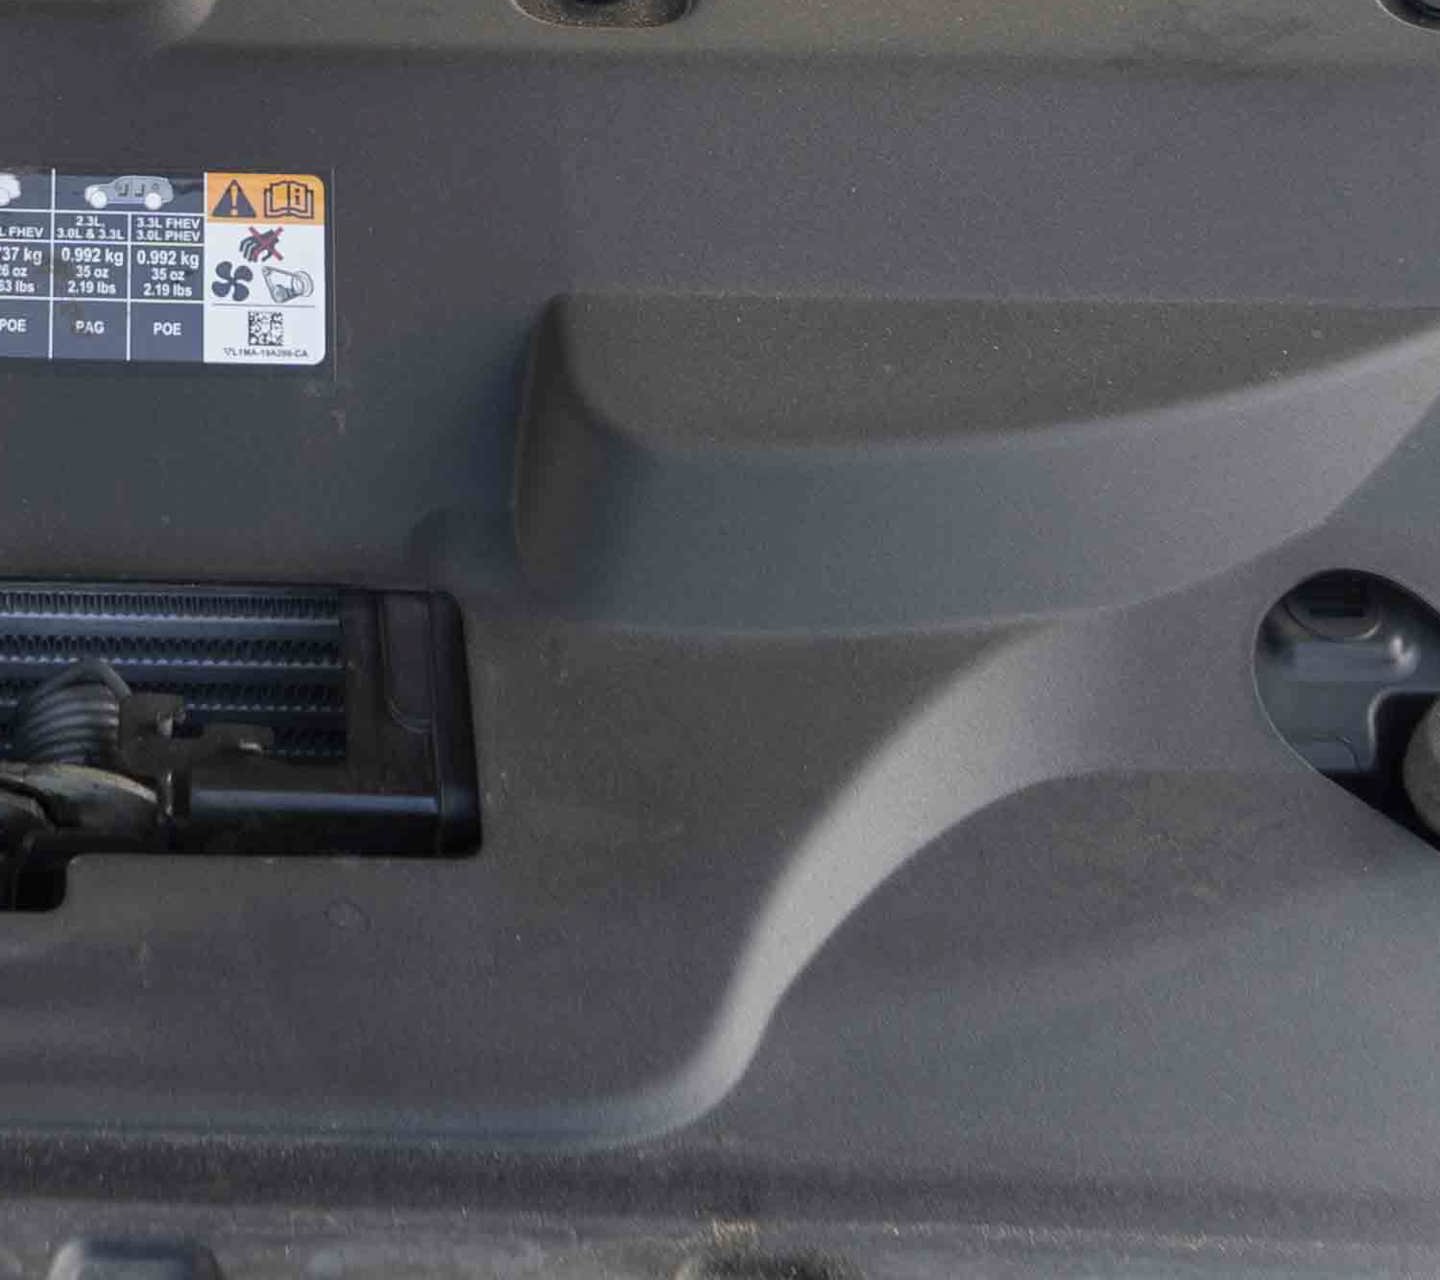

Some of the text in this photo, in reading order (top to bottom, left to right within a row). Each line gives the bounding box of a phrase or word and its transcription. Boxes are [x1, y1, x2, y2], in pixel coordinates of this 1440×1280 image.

[136, 217, 201, 229] 3.3L FHEV
[8, 226, 44, 238] FHEV
[56, 227, 125, 240] 3.0L & 3.3L
[136, 229, 201, 242] 3.0L PHEV
[23, 247, 43, 266] kg
[61, 247, 124, 266] 0.992 kg
[136, 249, 200, 269] 0.992 kg
[12, 266, 28, 277] oz
[75, 265, 110, 279] 35 oz
[151, 267, 185, 281] 35 oz
[15, 280, 35, 293] lbs
[67, 280, 117, 295] 2.19 lbs
[143, 282, 193, 297] 2.19 lbs
[75, 319, 105, 335] PAG
[153, 321, 183, 337] POE
